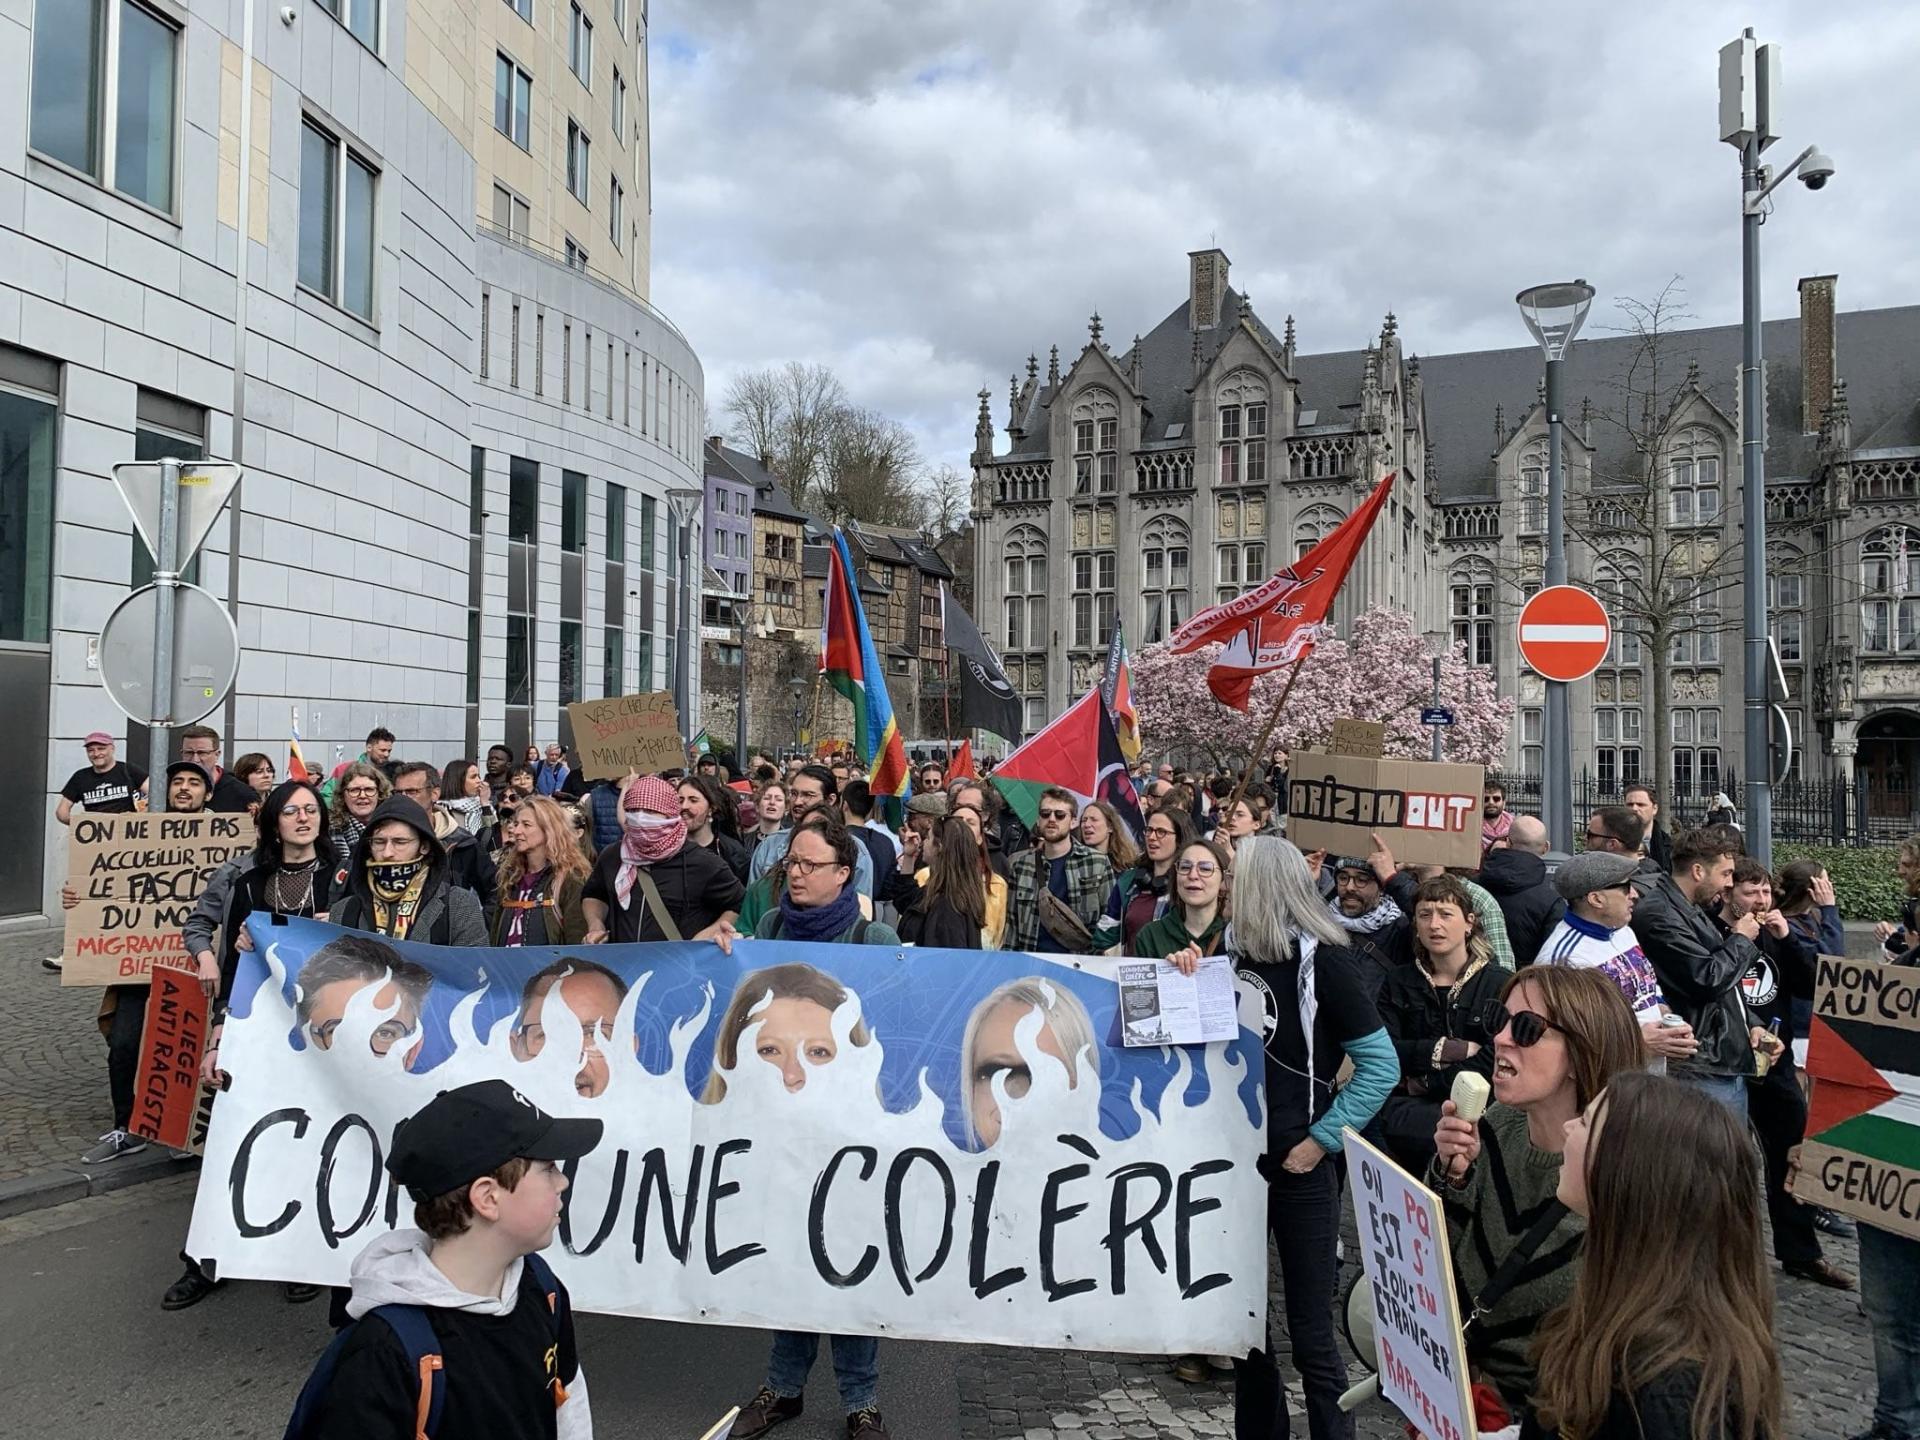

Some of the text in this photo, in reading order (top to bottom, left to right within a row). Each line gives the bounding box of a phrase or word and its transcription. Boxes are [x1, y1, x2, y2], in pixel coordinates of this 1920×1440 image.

[1403, 790, 1477, 832] OUT
[75, 817, 240, 844] ON NE PEUT PAS
[88, 876, 115, 899] LE
[100, 904, 142, 930] DU
[1817, 960, 1883, 993] NON
[1818, 989, 1867, 1016] AU
[137, 979, 180, 1141] ANTI RACISTE
[1361, 1159, 1384, 1204] ON
[228, 1107, 1235, 1302] COUNE COLÈRE
[1368, 1200, 1404, 1263] EST
[1373, 1249, 1417, 1314] TOUS
[1416, 1282, 1438, 1317] EN
